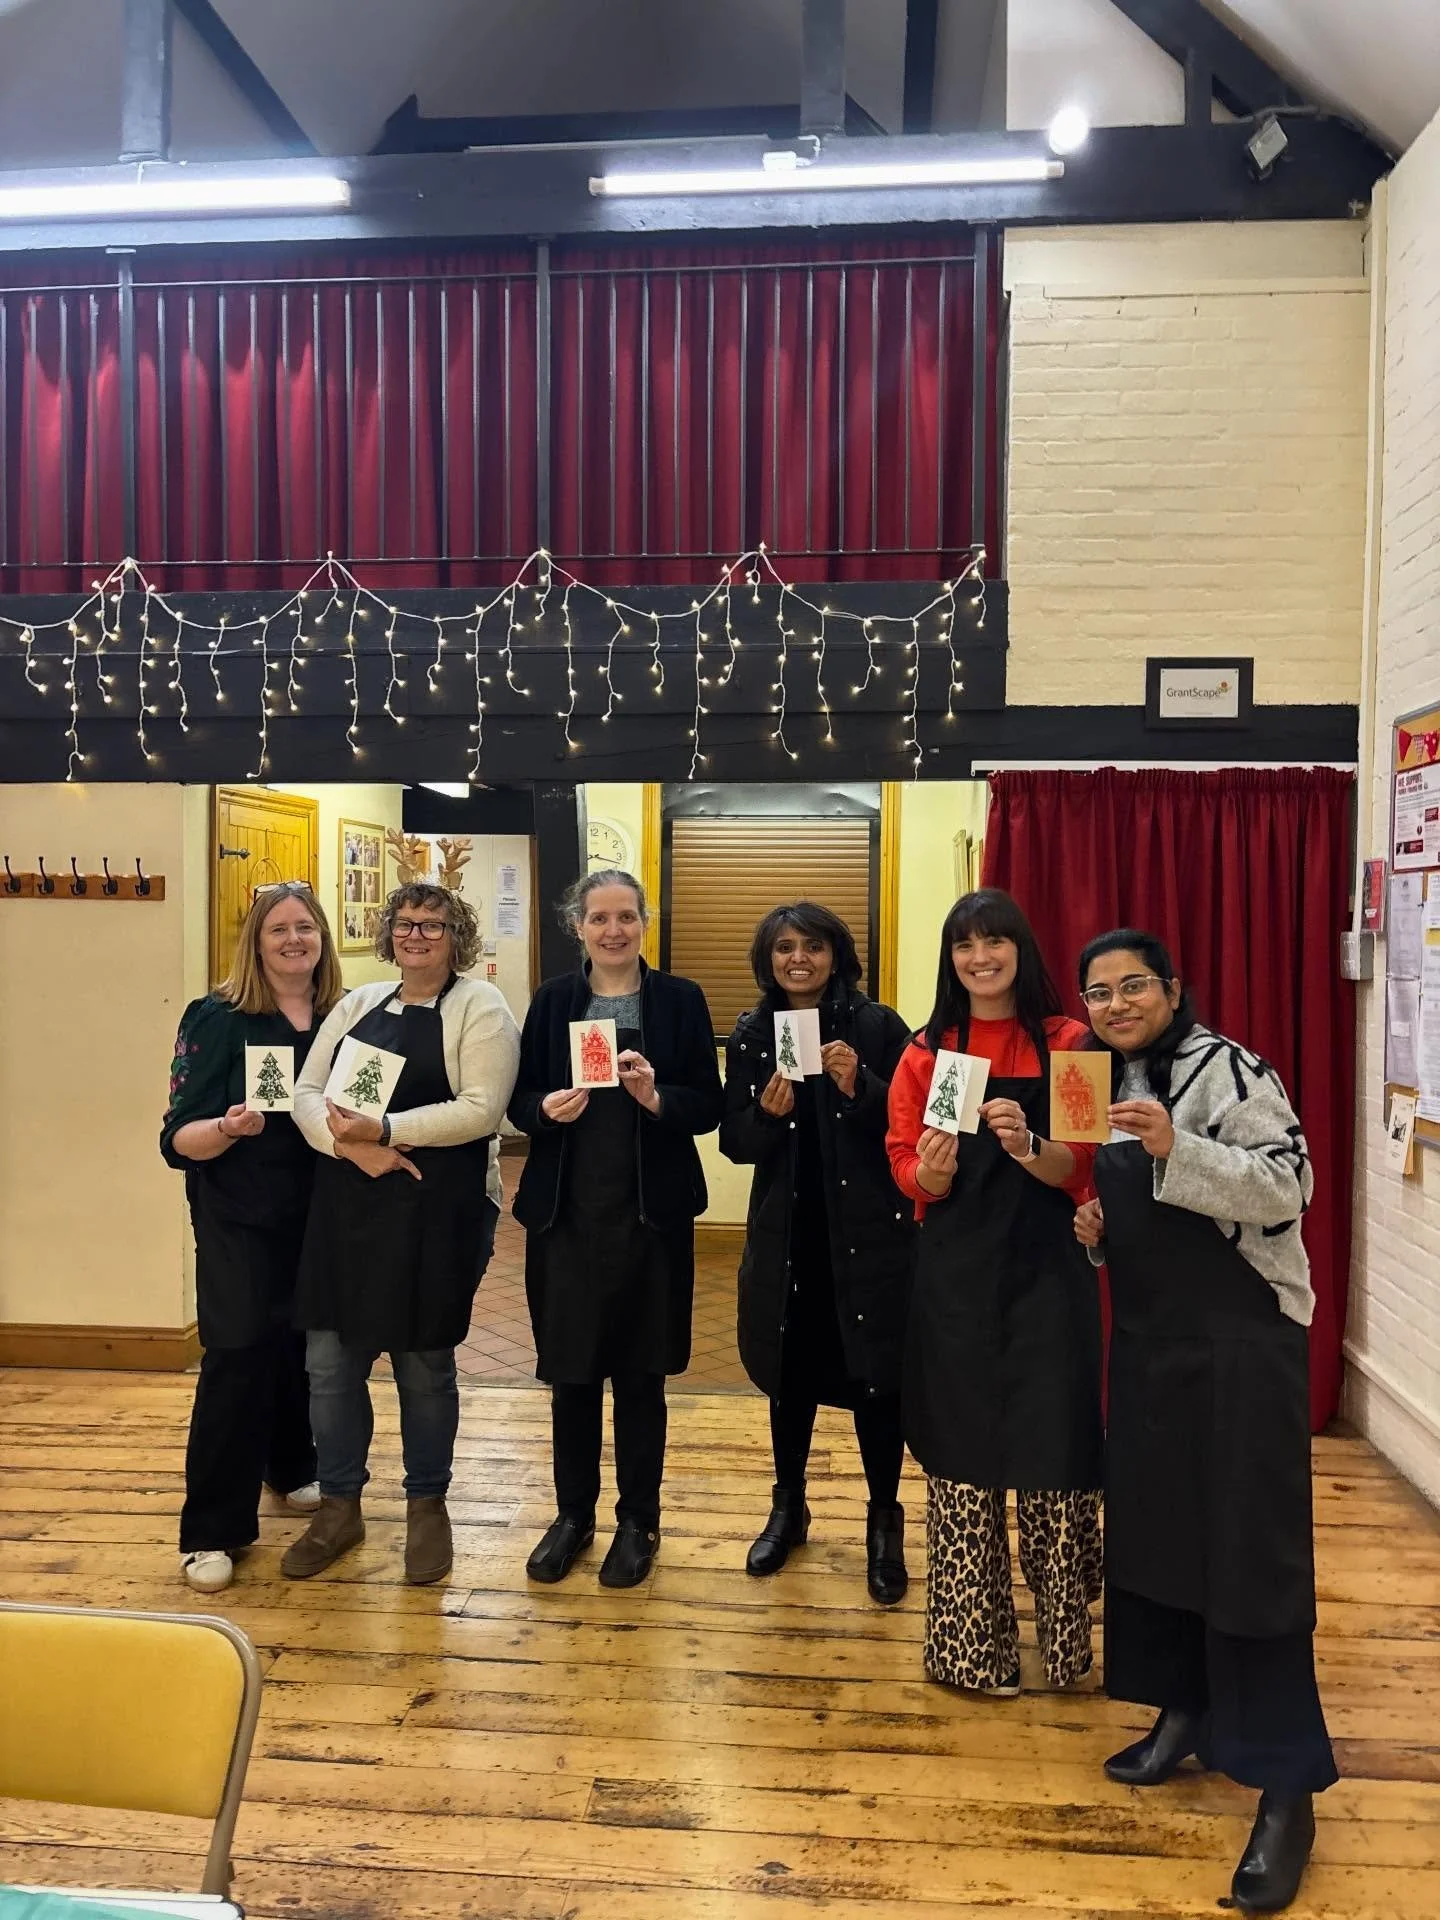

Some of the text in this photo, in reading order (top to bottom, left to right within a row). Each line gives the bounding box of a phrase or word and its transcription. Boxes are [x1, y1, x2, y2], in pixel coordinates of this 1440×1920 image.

[1166, 687, 1221, 700] GrantScape
[590, 827, 599, 837] 12
[604, 831, 608, 840] 1
[612, 839, 619, 849] 2
[616, 852, 622, 861] 3
